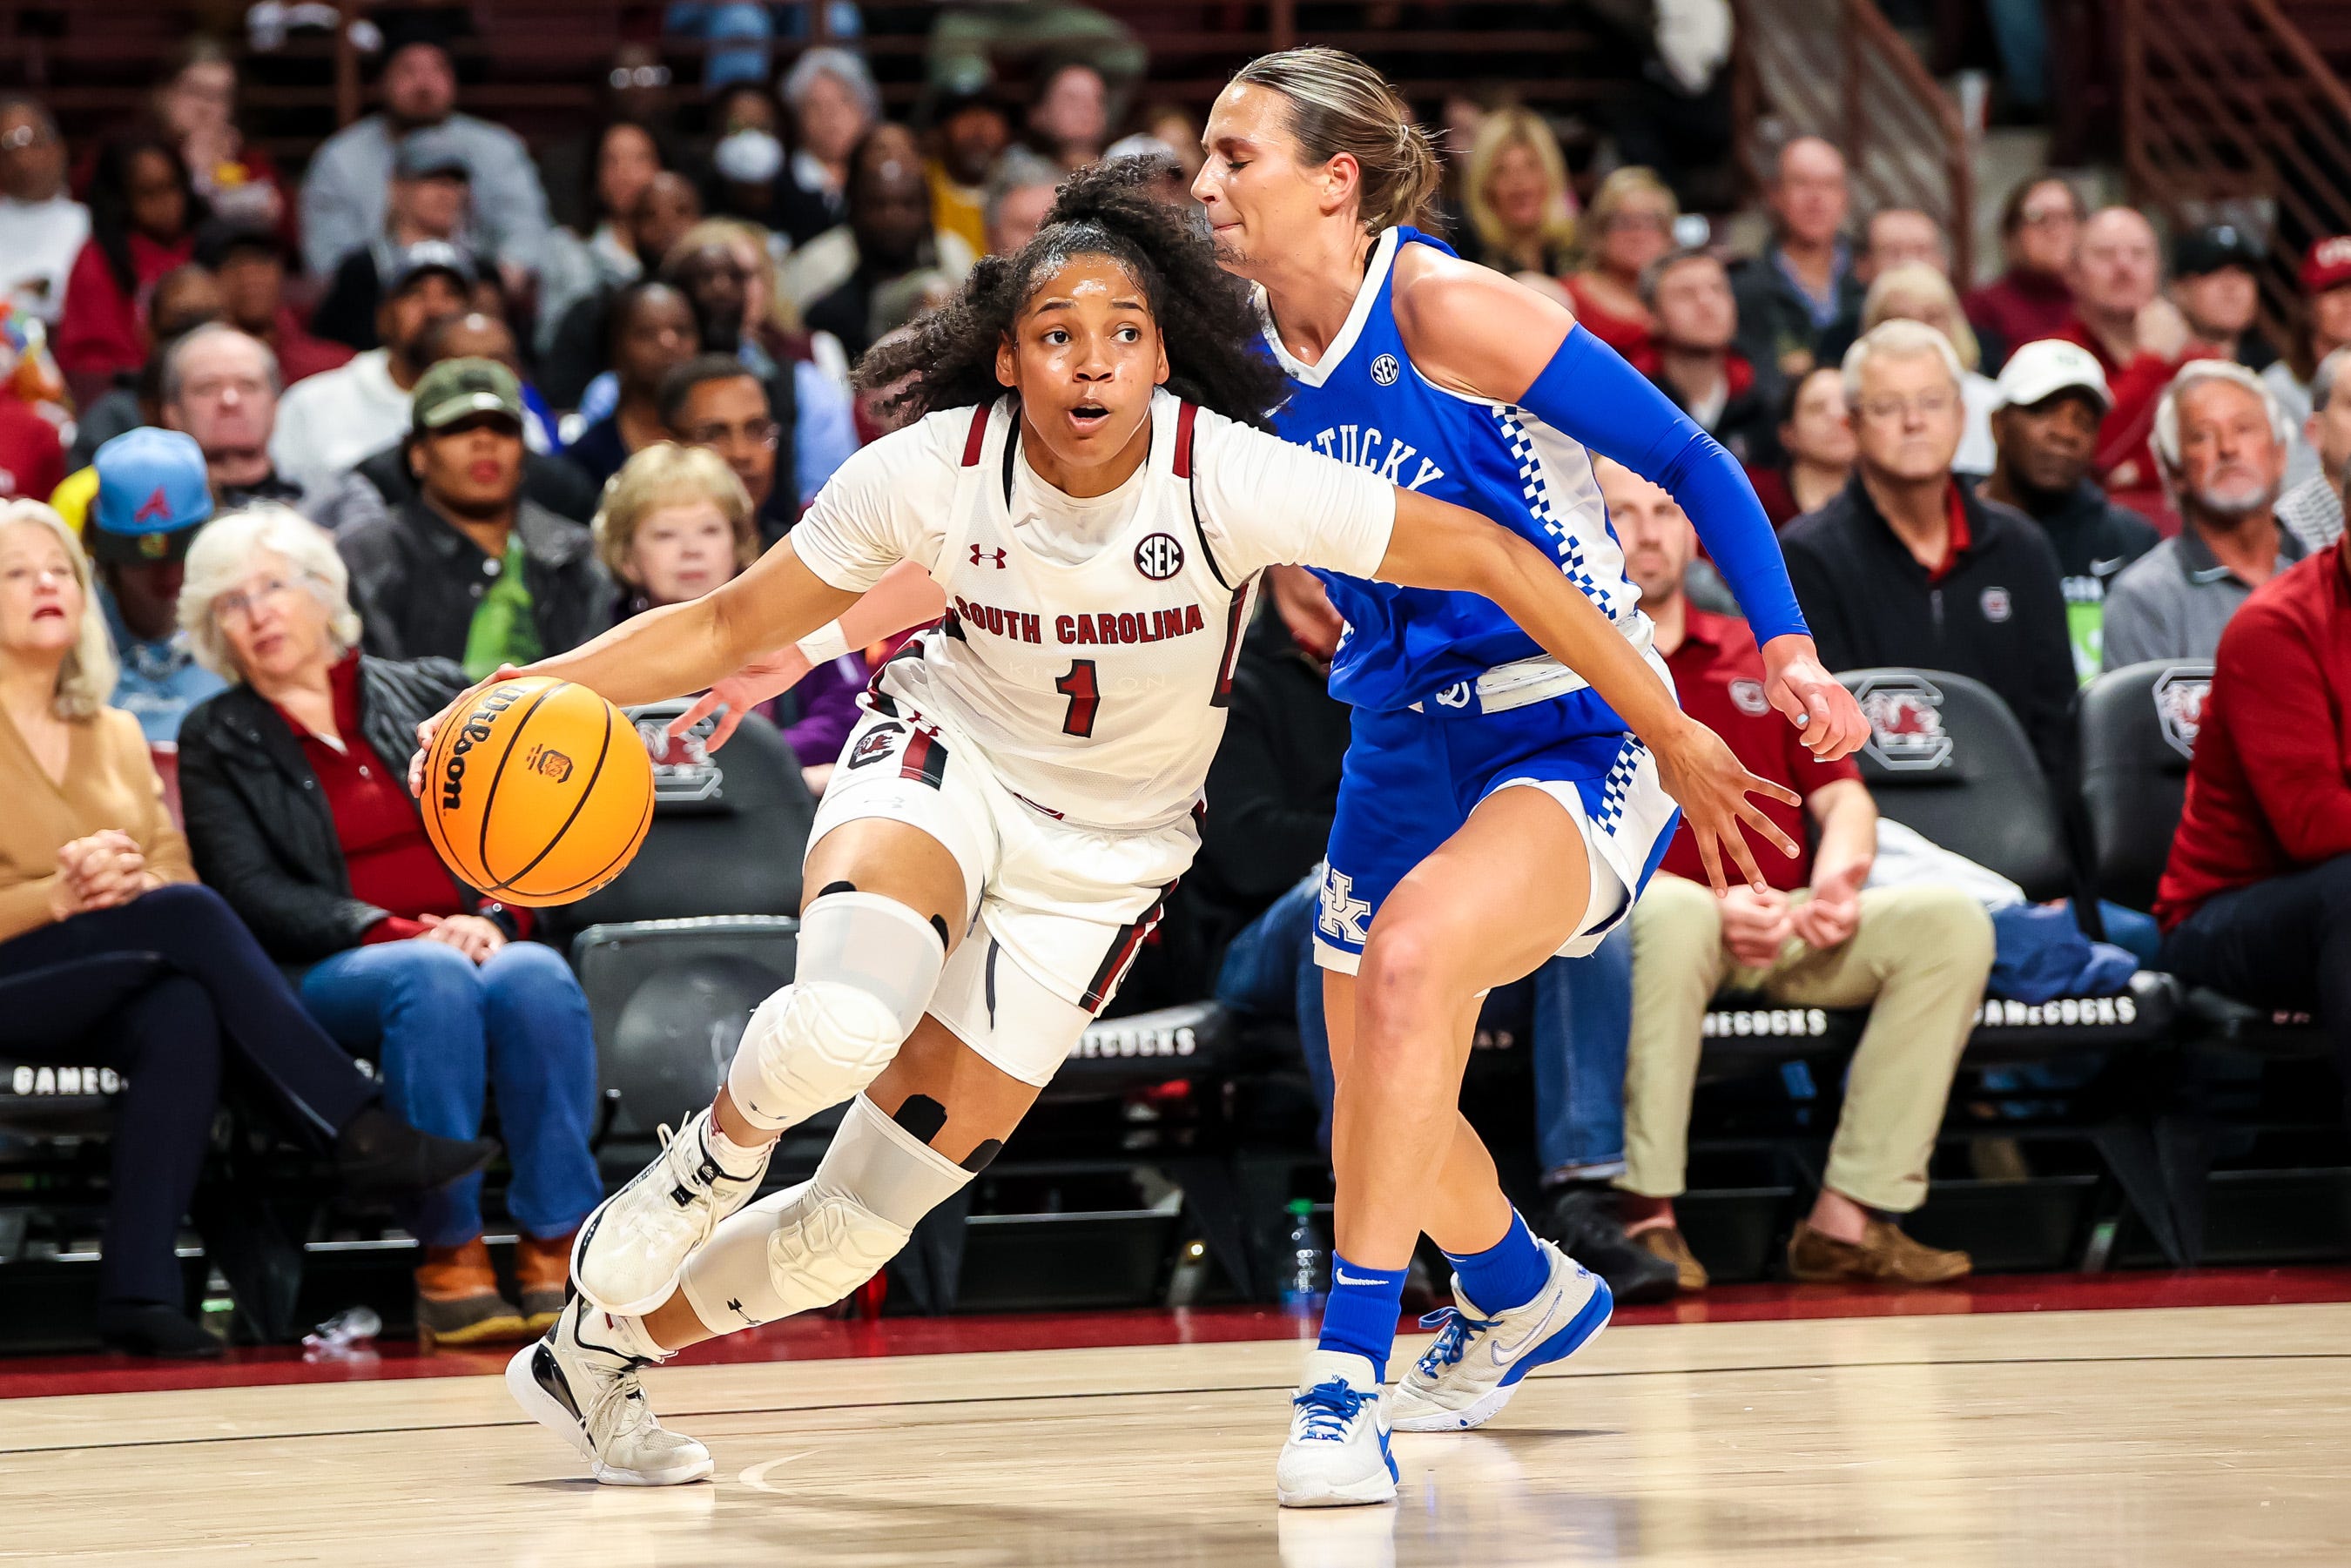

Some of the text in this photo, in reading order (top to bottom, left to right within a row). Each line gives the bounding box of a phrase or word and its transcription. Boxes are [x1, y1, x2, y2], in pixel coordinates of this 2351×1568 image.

[1373, 356, 1398, 385] SEC
[1303, 425, 1445, 491] TUCKY
[1138, 535, 1181, 578] SEC
[954, 595, 1205, 645] SOUTH CAROLINA
[1054, 658, 1101, 739] 1
[442, 684, 526, 811] Wilson
